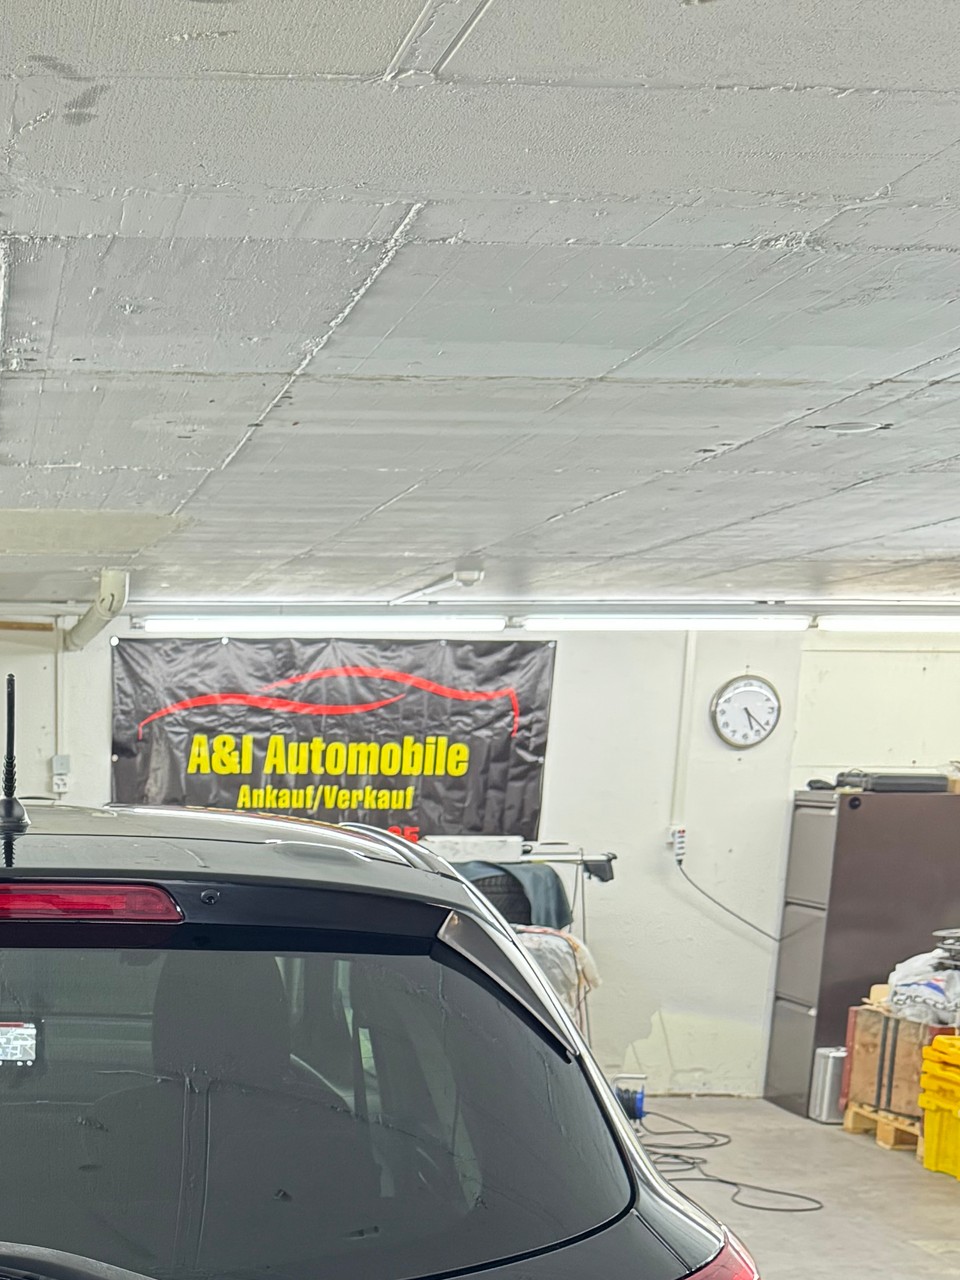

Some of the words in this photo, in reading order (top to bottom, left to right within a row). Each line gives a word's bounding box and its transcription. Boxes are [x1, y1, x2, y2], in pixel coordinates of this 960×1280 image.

[187, 733, 255, 775] A&I
[263, 734, 470, 776] Automobile
[236, 784, 415, 812] Ankauf/Verkauf
